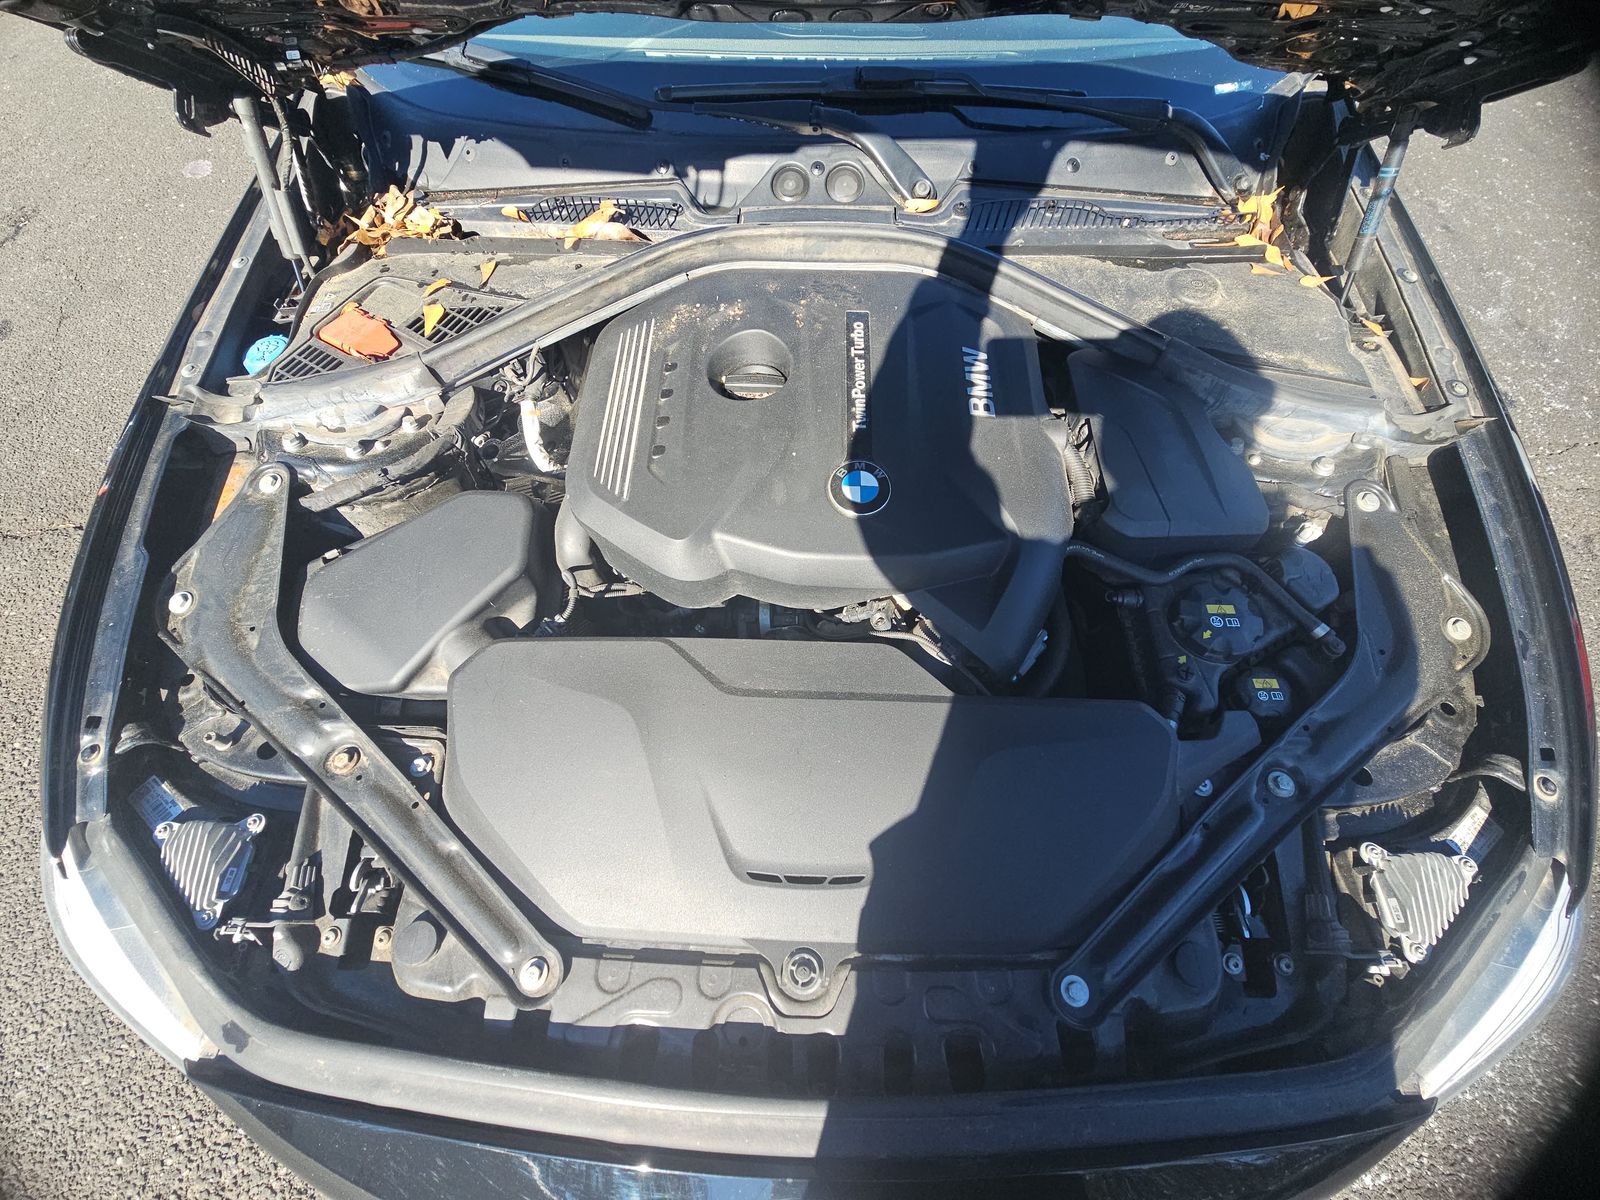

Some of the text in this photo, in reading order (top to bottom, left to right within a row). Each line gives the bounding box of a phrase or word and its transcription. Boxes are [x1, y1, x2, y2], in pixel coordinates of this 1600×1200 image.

[850, 321, 867, 433] TwinPower Turbo
[961, 346, 996, 418] BMW
[836, 462, 885, 479] BMW
